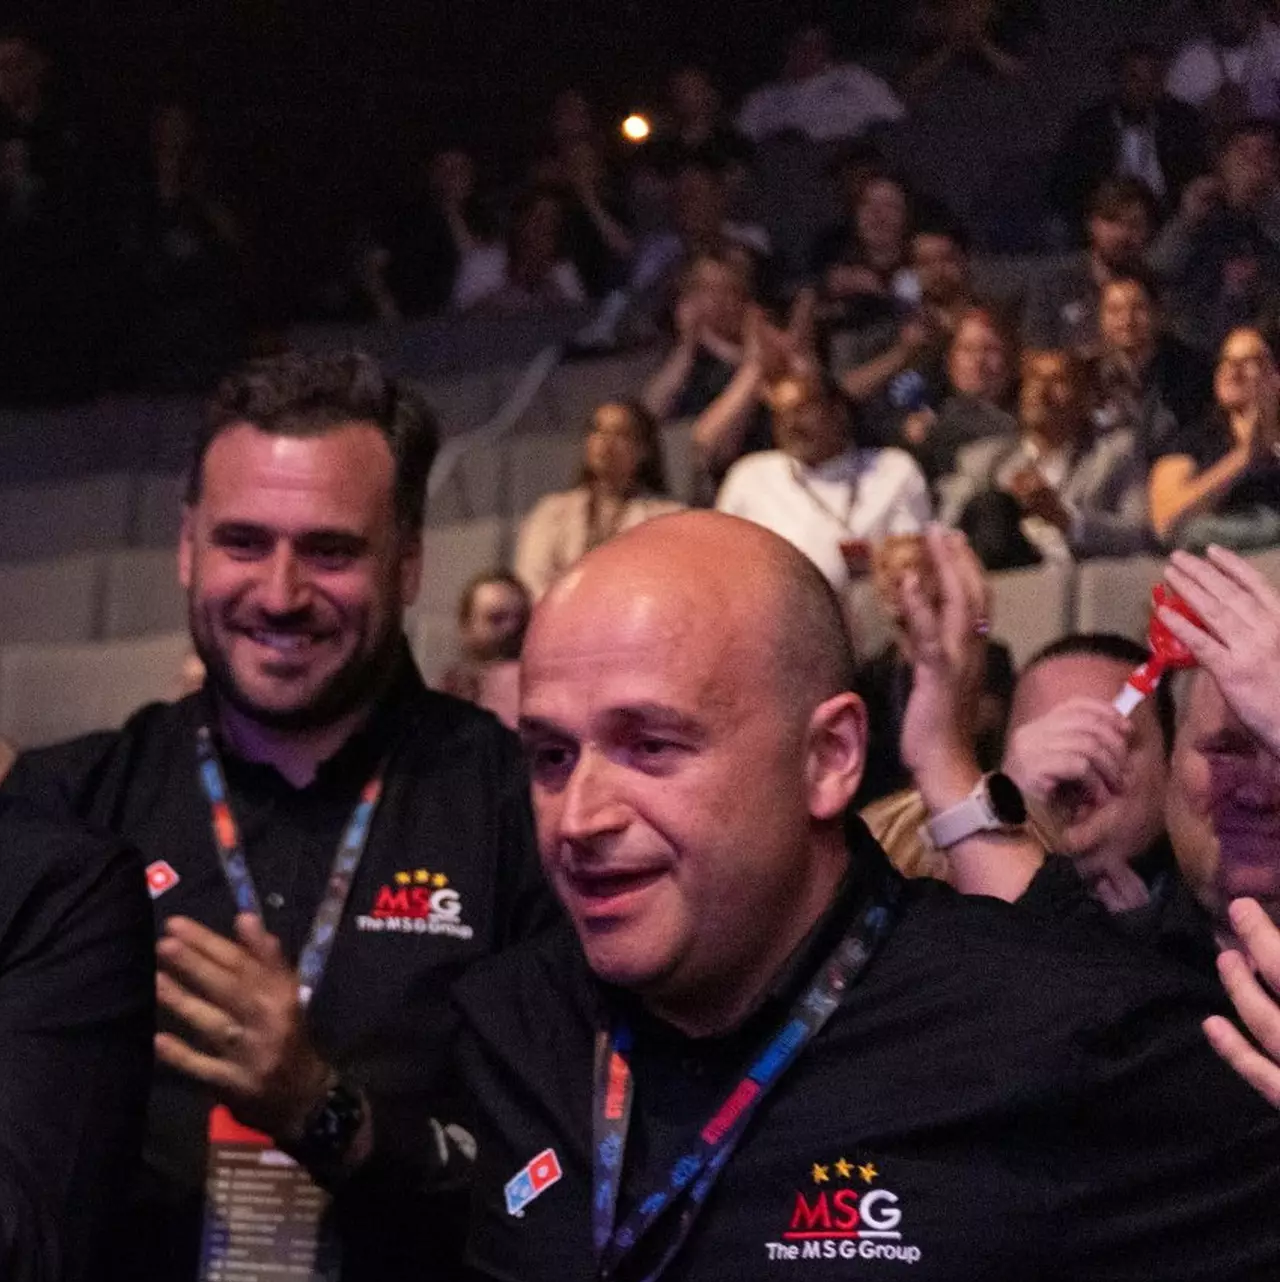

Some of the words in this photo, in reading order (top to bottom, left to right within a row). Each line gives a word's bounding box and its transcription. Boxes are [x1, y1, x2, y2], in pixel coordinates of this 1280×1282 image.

[374, 884, 462, 917] MSG
[789, 1188, 902, 1231] MSG
[765, 1242, 800, 1261] The
[858, 1240, 922, 1265] Group
